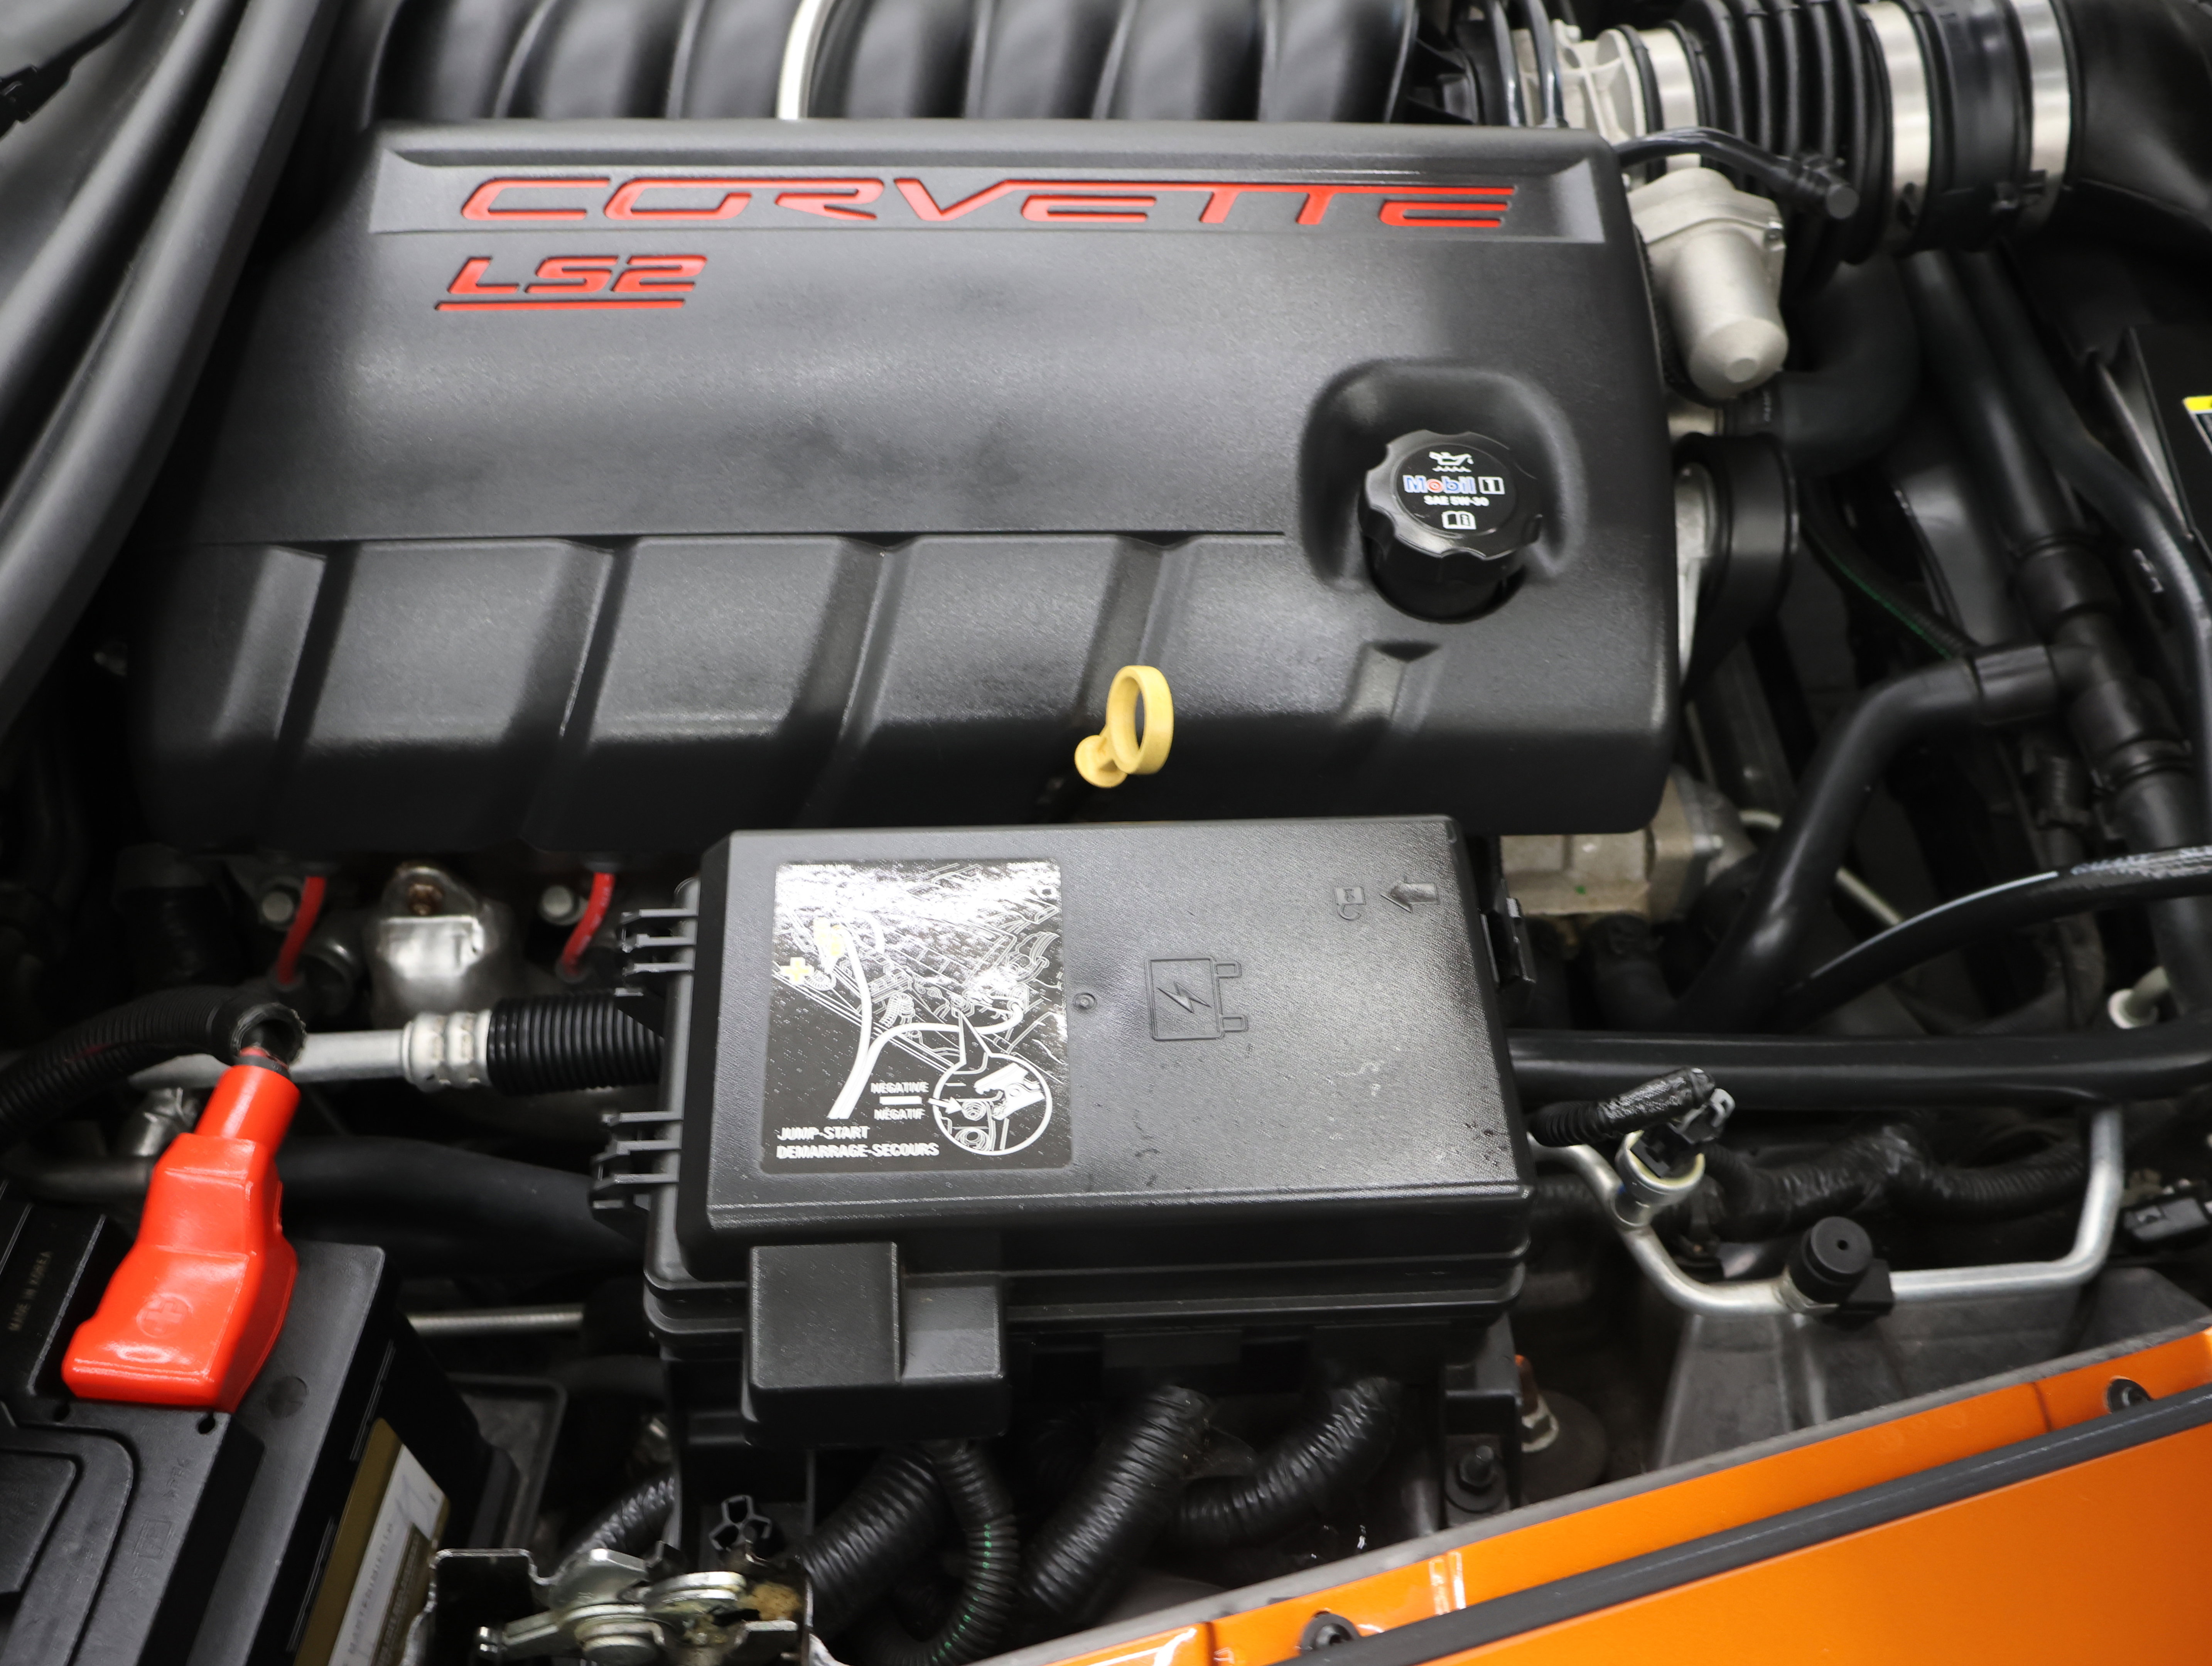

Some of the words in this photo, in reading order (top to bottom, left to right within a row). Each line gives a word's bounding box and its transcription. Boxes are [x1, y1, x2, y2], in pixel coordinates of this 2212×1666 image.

[461, 177, 1515, 228] CORVETTE
[447, 255, 708, 294] LS2
[1403, 474, 1477, 494] Mobil
[1424, 495, 1449, 506] SAE
[1449, 496, 1490, 506] 5W-30
[870, 1082, 929, 1094] NEGATIVE
[777, 1126, 871, 1140] JUMP-START
[776, 1142, 940, 1159] DEMARRAGE-SECOURS
